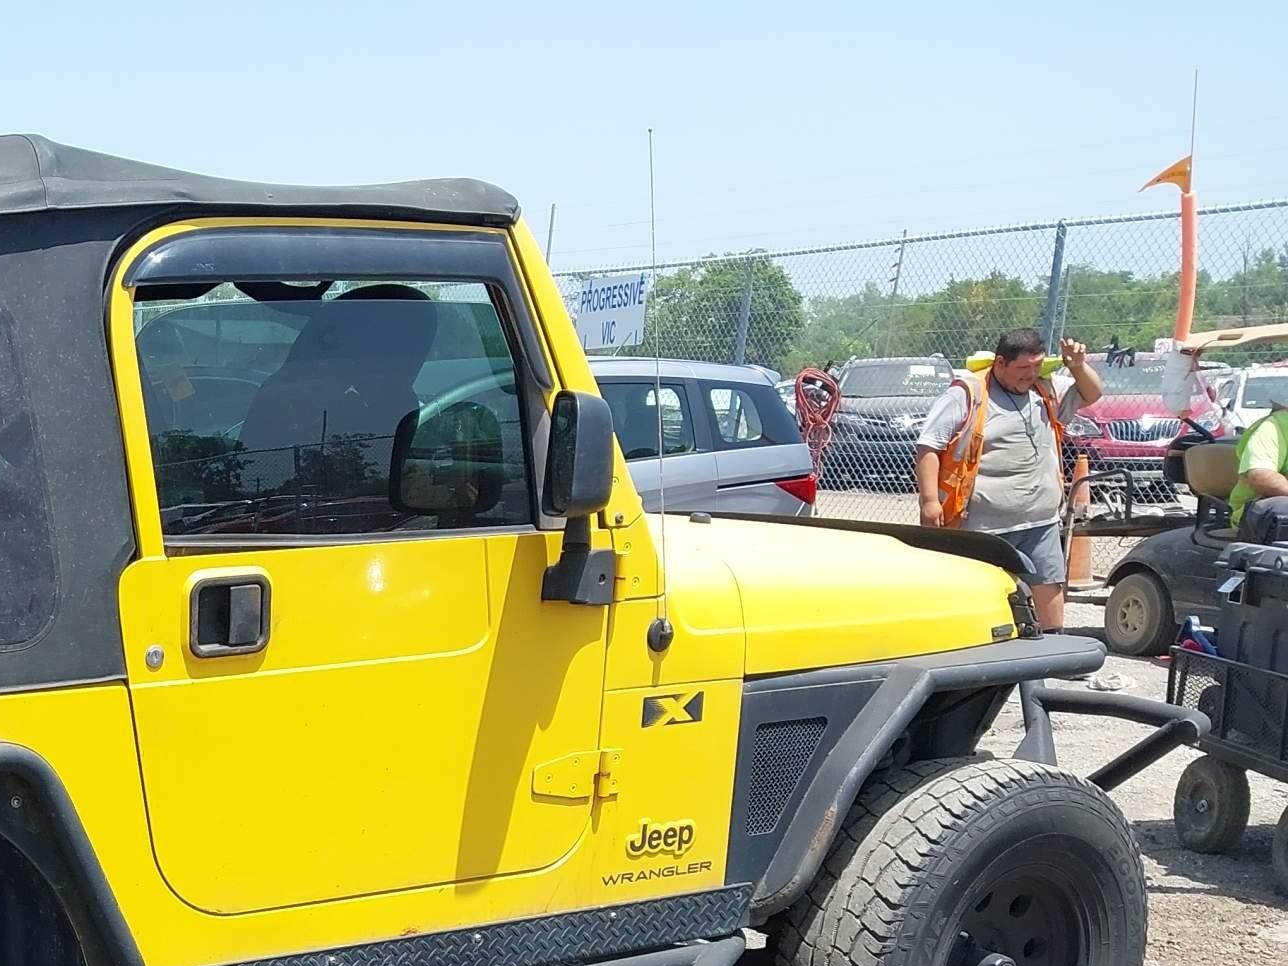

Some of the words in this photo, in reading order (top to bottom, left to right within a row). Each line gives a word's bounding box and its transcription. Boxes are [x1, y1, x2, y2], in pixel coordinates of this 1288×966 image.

[580, 281, 645, 313] PROGRESSIVE
[601, 321, 616, 345] VIC
[644, 691, 703, 728] X
[629, 823, 693, 852] Jeep
[602, 861, 712, 887] WRANGLER
